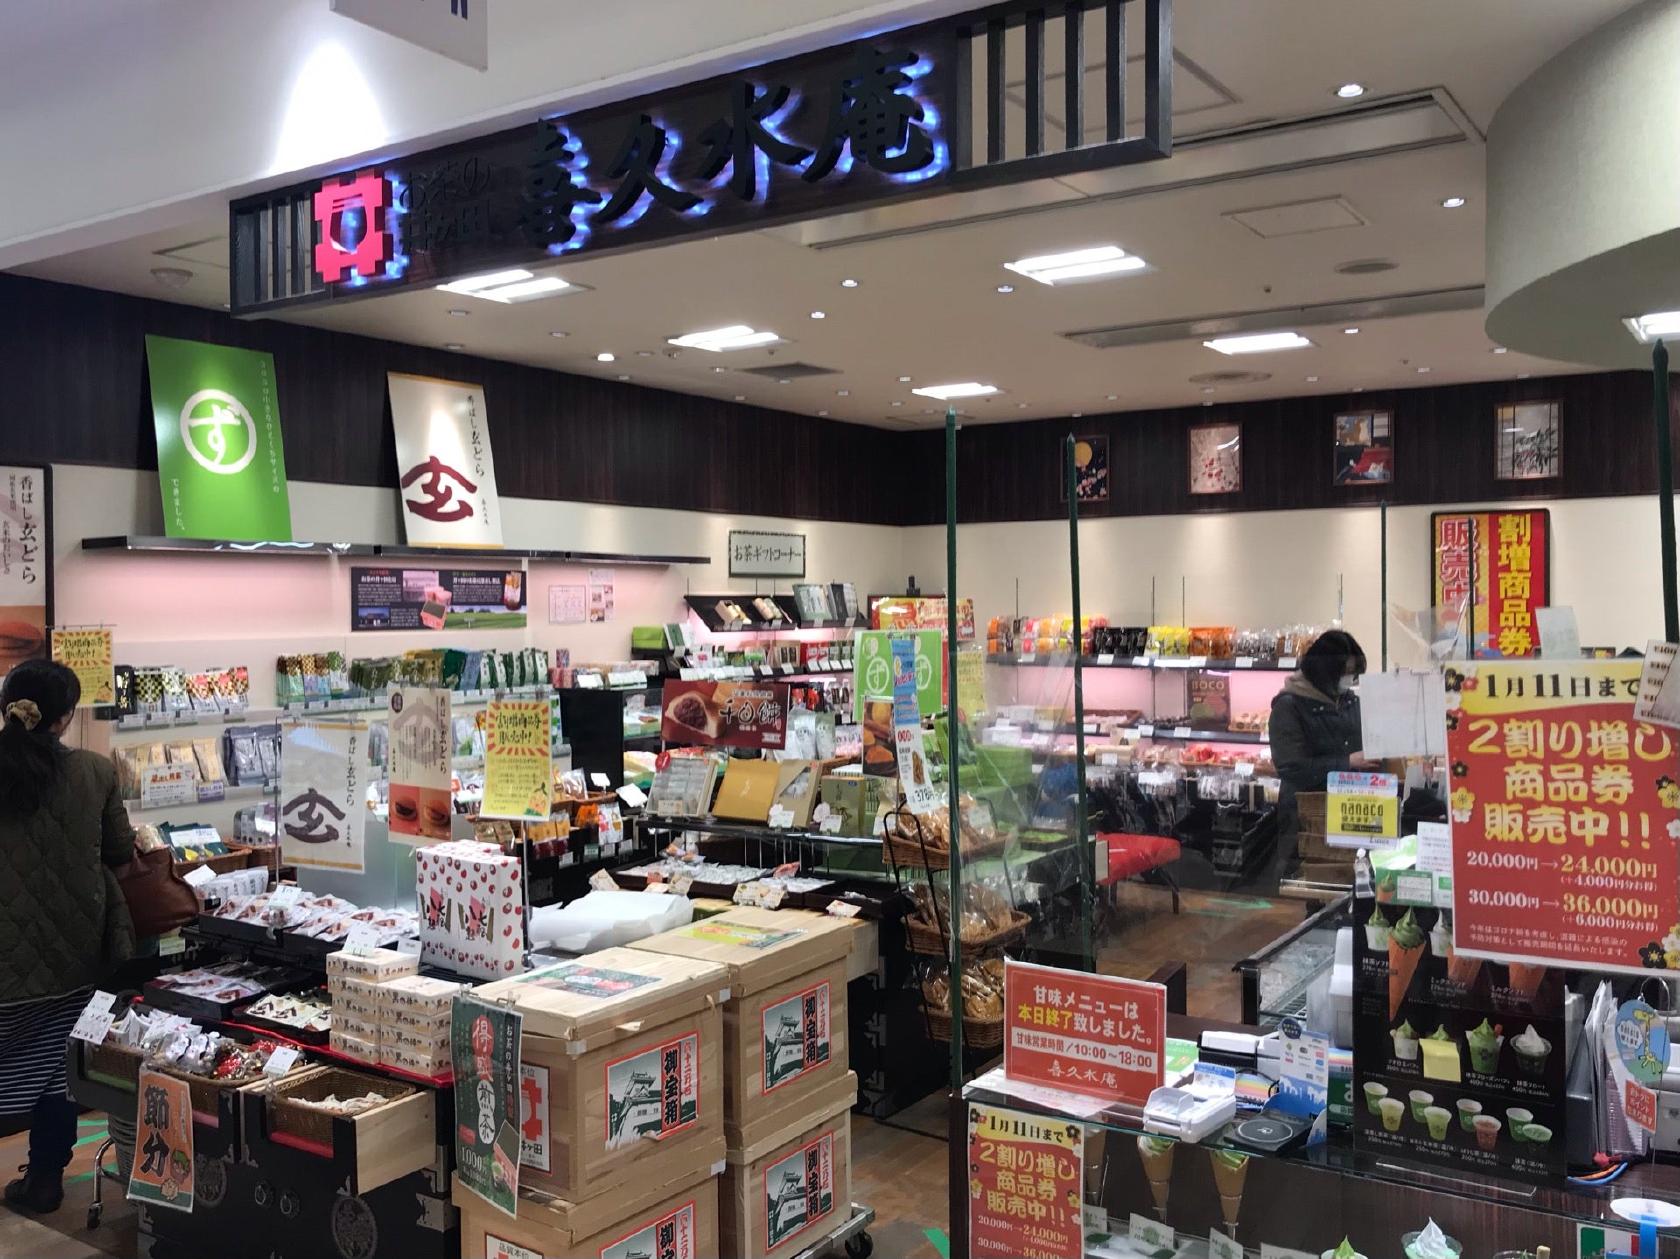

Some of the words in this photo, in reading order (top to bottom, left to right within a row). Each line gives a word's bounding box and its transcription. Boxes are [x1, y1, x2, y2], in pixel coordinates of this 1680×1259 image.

[518, 48, 946, 255] 喜久水庵
[400, 456, 478, 523] 玄
[20, 474, 38, 585] 香ばし玄どら
[734, 543, 803, 563] お茶ギフトコーナー
[1440, 517, 1481, 613] 販売中
[1497, 513, 1533, 657] 割増商品券
[1467, 718, 1673, 763] 2割り増し
[1503, 761, 1635, 805] 商品券
[282, 787, 347, 844] 玄
[1341, 801, 1384, 817] nanaco
[1466, 850, 1538, 870] 20,000円
[1560, 853, 1658, 879] 24,000円
[1468, 888, 1540, 909] 30,000円
[1562, 891, 1660, 920] 36,000円
[1017, 1003, 1154, 1045] 本日終了致しました。
[1033, 984, 1140, 1021] 甘味メニューは
[804, 994, 816, 1064] 御宝箱
[664, 1048, 678, 1126] 御宝箱
[1047, 1059, 1119, 1090] 喜久水庵
[140, 1086, 170, 1178] 節分
[990, 1115, 1064, 1143] 1月11日まで
[807, 1148, 818, 1218] 御宝箱
[979, 1142, 1076, 1181] 2割り増し
[996, 1170, 1057, 1201] 商品券
[977, 1215, 1013, 1231] 20,000円
